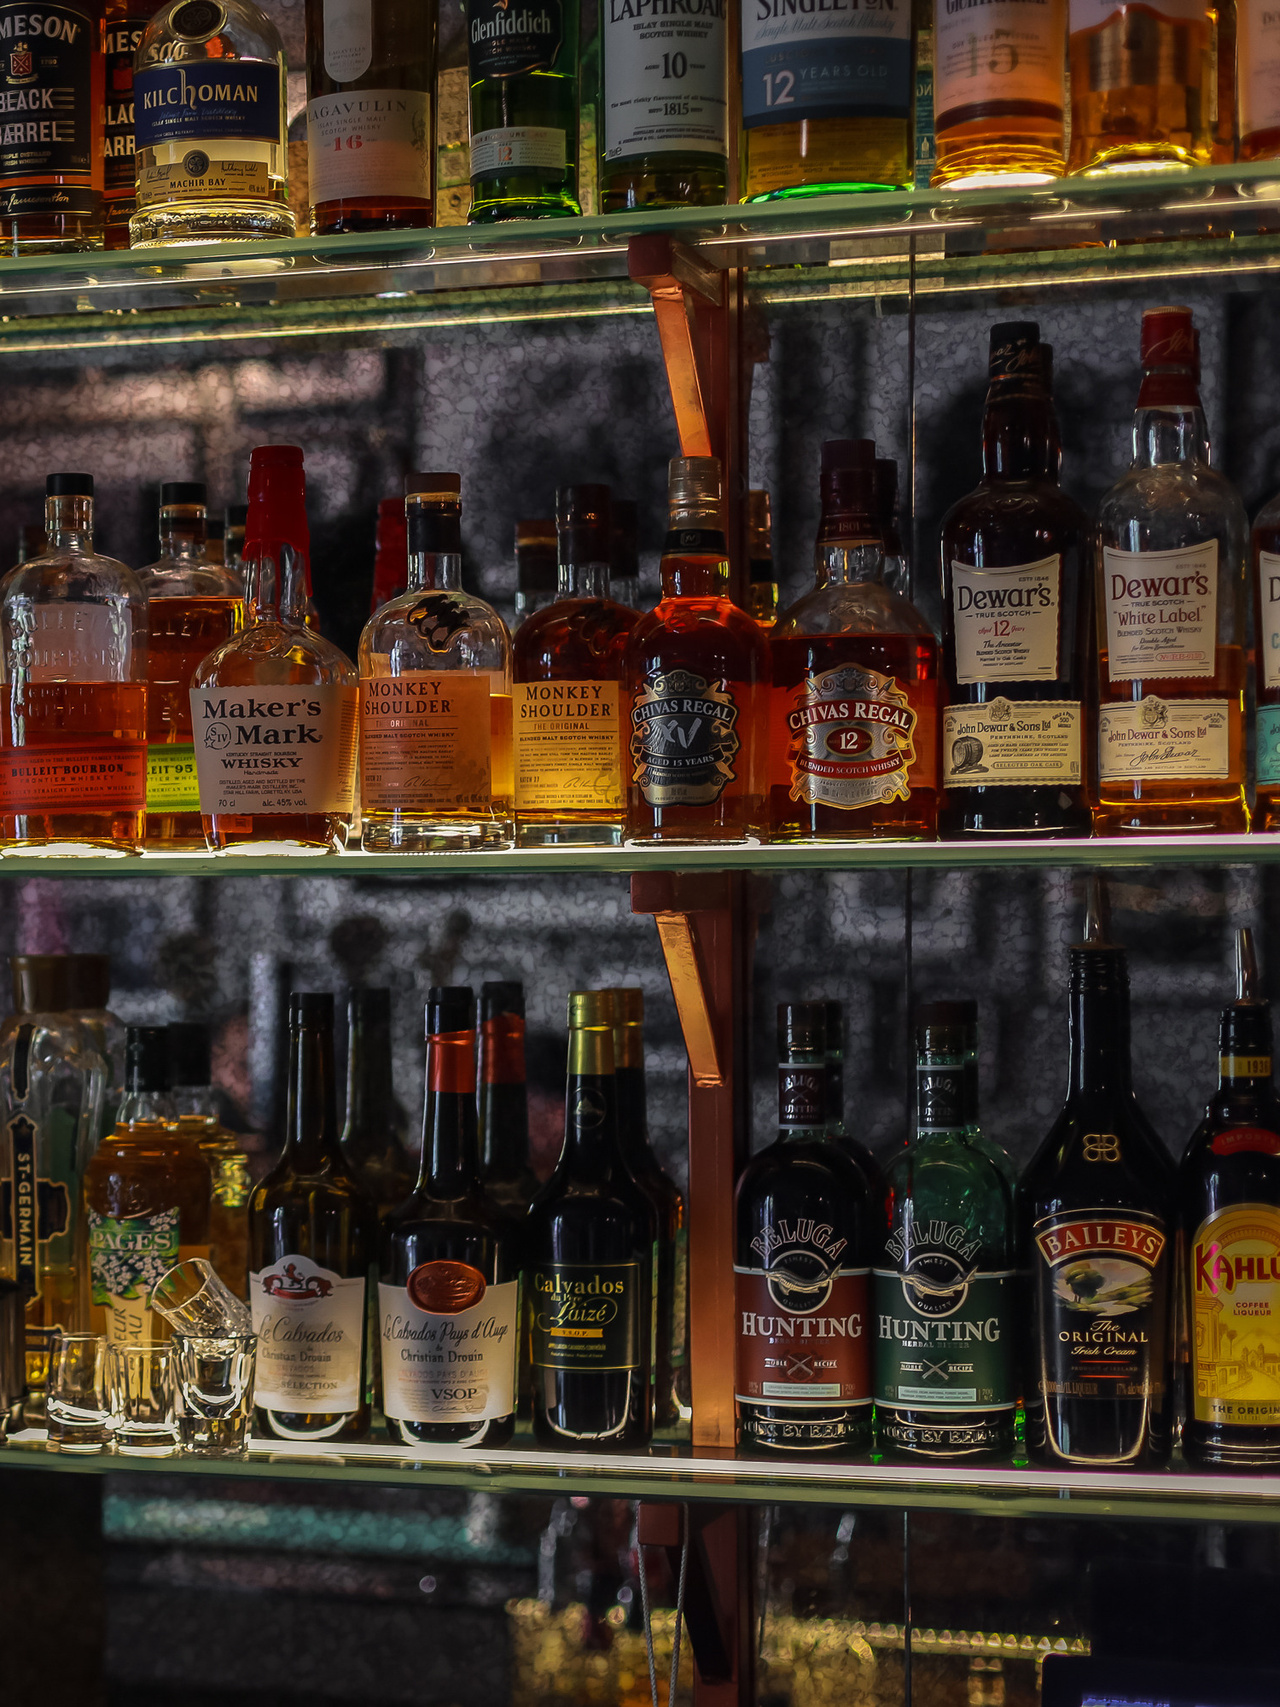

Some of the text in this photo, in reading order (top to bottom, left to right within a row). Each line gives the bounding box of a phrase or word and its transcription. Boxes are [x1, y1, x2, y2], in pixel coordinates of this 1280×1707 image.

[471, 9, 552, 44] Glenfiddich
[633, 21, 691, 31] ISLAY SINGLE
[639, 30, 709, 39] SCOTCH WHISKY
[966, 32, 1019, 78] 15
[662, 52, 688, 79] 10
[762, 64, 888, 107] 12 YEARS OLD
[308, 101, 407, 123] LAGAVULIN
[663, 102, 689, 116] 1815
[321, 124, 381, 136] SCOTCH WHISKY
[333, 135, 363, 152] 16
[497, 146, 513, 162] 12
[170, 178, 226, 189] MACHIR BAY
[838, 521, 861, 532] 1801
[1111, 571, 1209, 601] Dewar's
[957, 583, 1051, 611] Dewar's
[997, 610, 1031, 618] SCOTCH
[993, 620, 1011, 637] 12
[1117, 629, 1144, 637] BLENDED
[368, 681, 442, 698] MONKEY
[526, 685, 602, 700] MONKEY
[202, 698, 321, 719] Maker's
[364, 700, 451, 716] SHOULDER
[521, 703, 611, 718] SHOULDER
[633, 699, 731, 724] CHIVAS REGAL
[788, 702, 911, 730] CHIVAS REGAL
[533, 722, 590, 731] THE ORIGINAL
[660, 717, 703, 749] XV
[957, 720, 1051, 735] John Dewar & Sons Ltd
[1108, 726, 1207, 743] John Dewar & Sons Ltd
[235, 725, 320, 746] Mark
[839, 732, 858, 751] 12
[221, 758, 304, 769] WHISKY
[646, 754, 715, 767] AGED 15 YEARS
[799, 757, 900, 774] BLENDED SCOTCH WHISKY
[12, 764, 124, 777] BULLEIT BOURBON
[147, 764, 194, 775] LEIT 95
[218, 799, 236, 808] 70 cl
[262, 798, 308, 808] alc. 45% vol.
[16, 1152, 33, 1268] ST-GERMAIN
[91, 1230, 175, 1252] PAGES
[750, 1218, 847, 1260] BELUGA
[885, 1219, 982, 1262] BELUGA
[1046, 1226, 1160, 1256] BAILEYS
[1195, 1243, 1280, 1295] KAHLÚ
[534, 1273, 625, 1294] Calvados
[917, 1298, 954, 1311] QUALITY
[1235, 1301, 1270, 1309] COFFEE
[549, 1300, 607, 1326] Laizé
[1233, 1309, 1272, 1317] LIQUEUR
[272, 1316, 344, 1343] Calvados
[391, 1319, 437, 1341] Calvados
[440, 1321, 469, 1347] Pays
[472, 1316, 509, 1343] d'Auge
[742, 1312, 863, 1338] HUNTING
[879, 1314, 1001, 1342] HUNTING
[1089, 1320, 1121, 1332] The
[902, 1340, 935, 1348] HERBAL
[1058, 1330, 1149, 1343] ORIGINAL
[261, 1349, 332, 1363] Christian Drouin
[400, 1349, 484, 1363] Christian Drouin
[1071, 1345, 1137, 1356] Irish Cream
[765, 1358, 838, 1369] NOBLE RECIPE
[900, 1361, 974, 1371] NOBLE RECIPE
[430, 1388, 478, 1400] VSOP
[1211, 1404, 1280, 1415] THE ORIGIN
